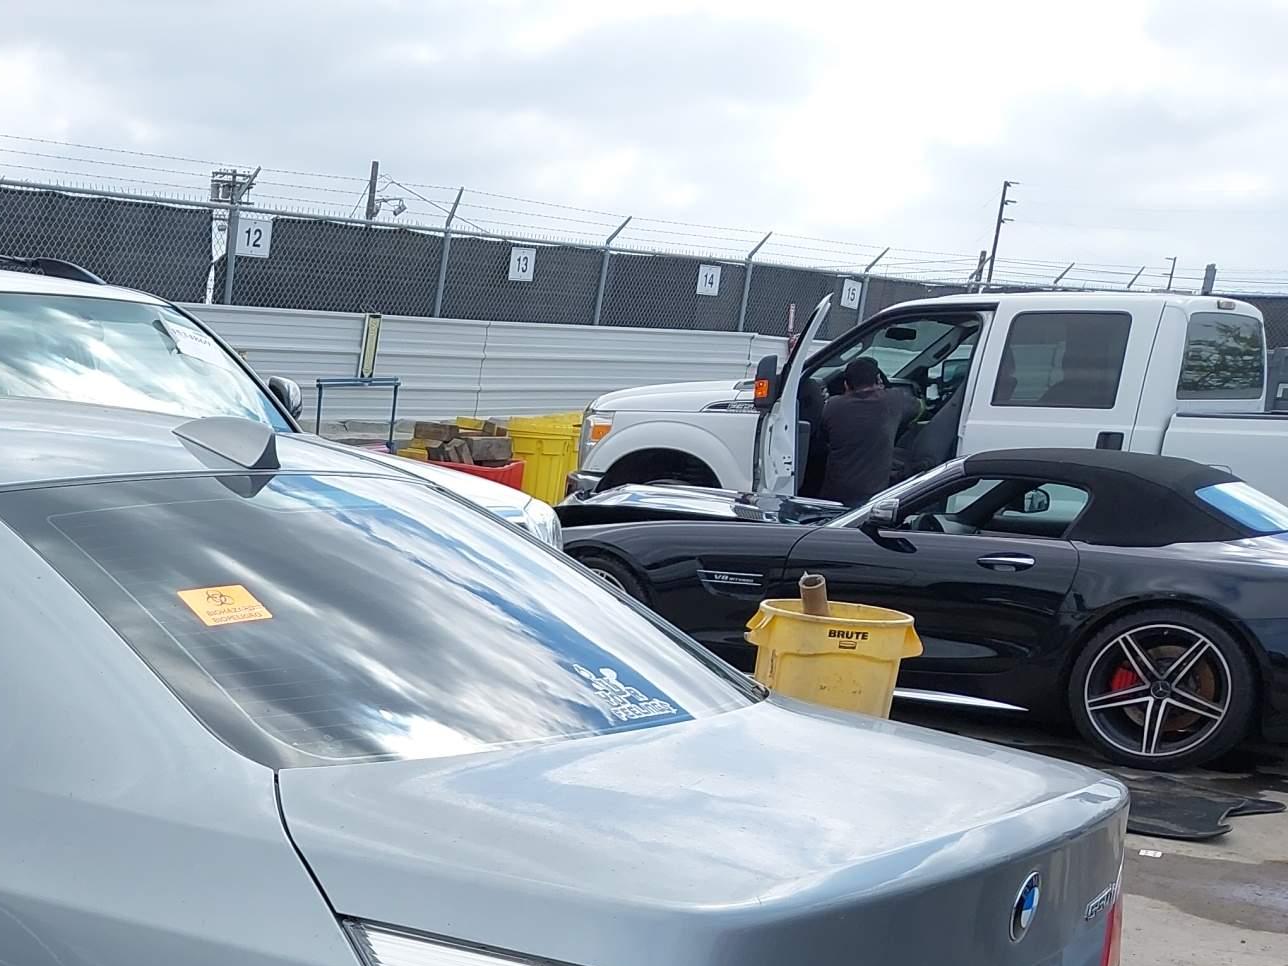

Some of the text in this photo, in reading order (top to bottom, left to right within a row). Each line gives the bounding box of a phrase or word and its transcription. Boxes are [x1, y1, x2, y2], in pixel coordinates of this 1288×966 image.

[245, 227, 262, 248] 12
[516, 255, 529, 273] 13
[704, 272, 714, 289] 14
[847, 287, 857, 302] 15
[828, 629, 869, 641] BRUTE
